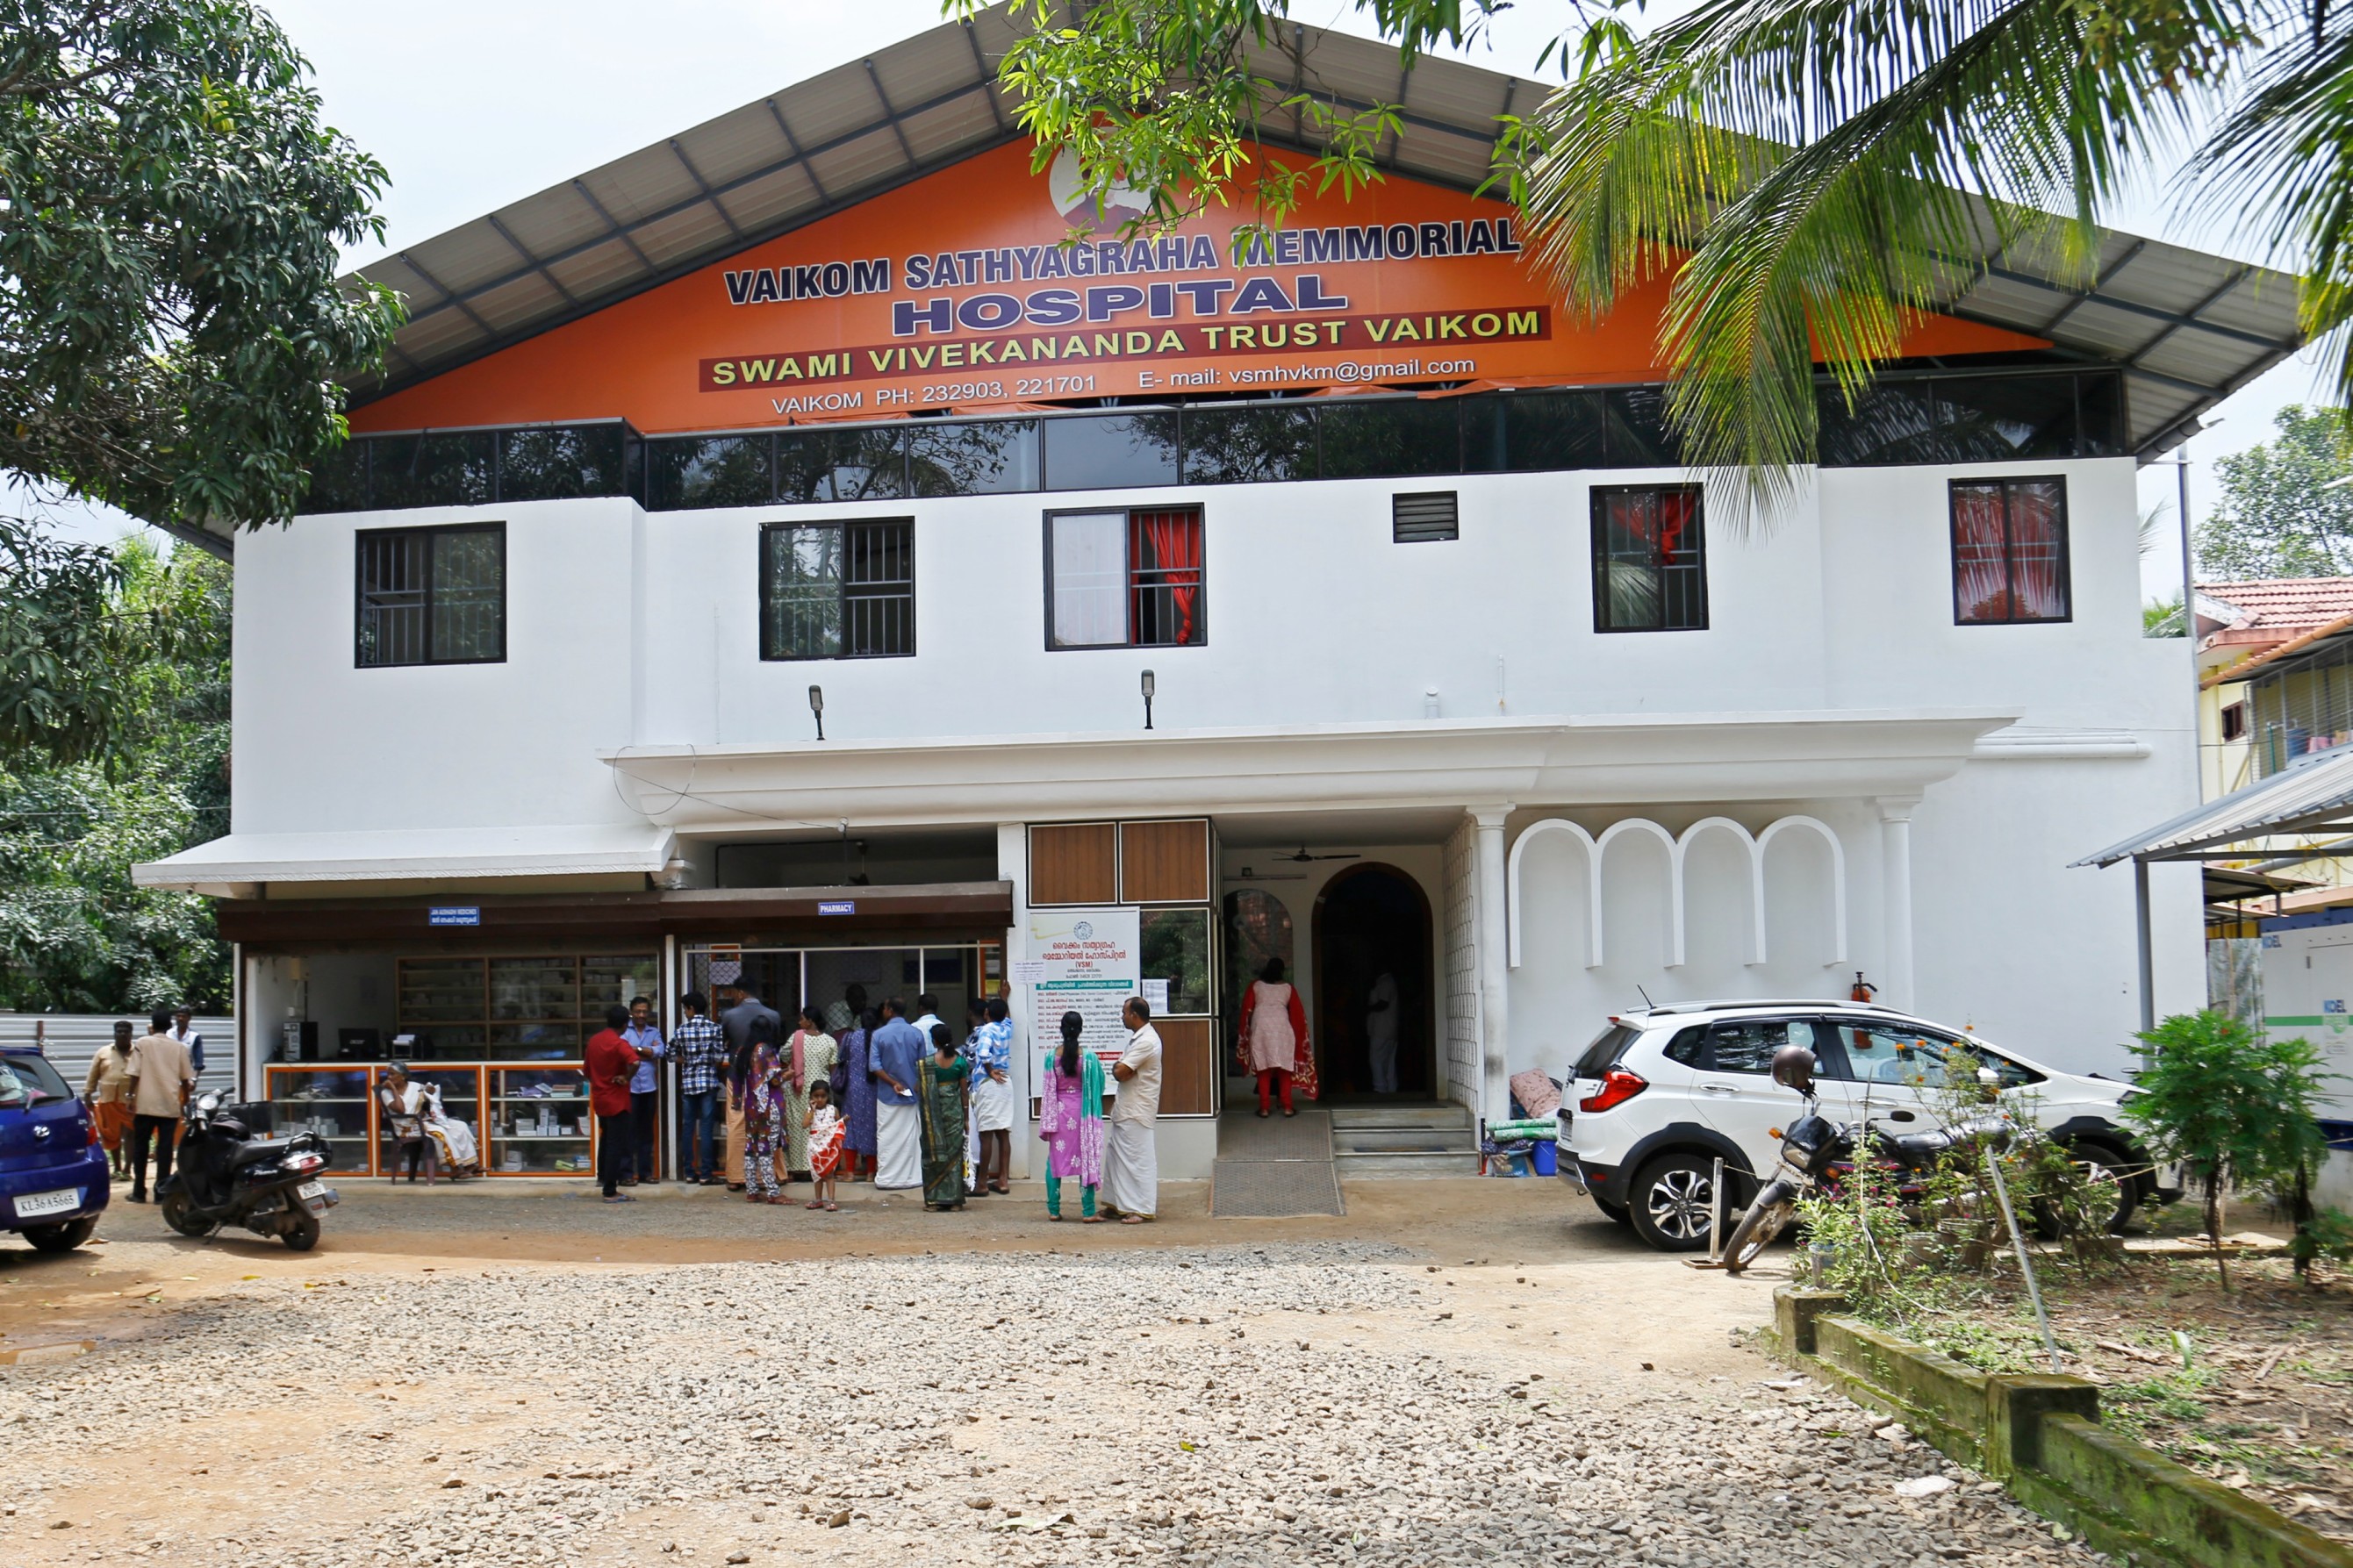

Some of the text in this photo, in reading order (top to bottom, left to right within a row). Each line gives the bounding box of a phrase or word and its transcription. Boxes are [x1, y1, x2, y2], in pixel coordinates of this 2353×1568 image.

[724, 218, 1521, 305] VAIKOM SATHYAGRAHA MEMMORIAL
[893, 274, 1348, 336] HOSPITAL
[712, 311, 1538, 384] SWAMI VIVEKANANDA TRUST VAIKOM
[771, 391, 862, 414] VAIKOM
[876, 388, 915, 406] PH:
[922, 381, 1008, 403] 232903,
[1015, 375, 1095, 395] 221701
[1170, 368, 1221, 386] mail:
[1229, 359, 1474, 383] vsmhvkm@gmail.com
